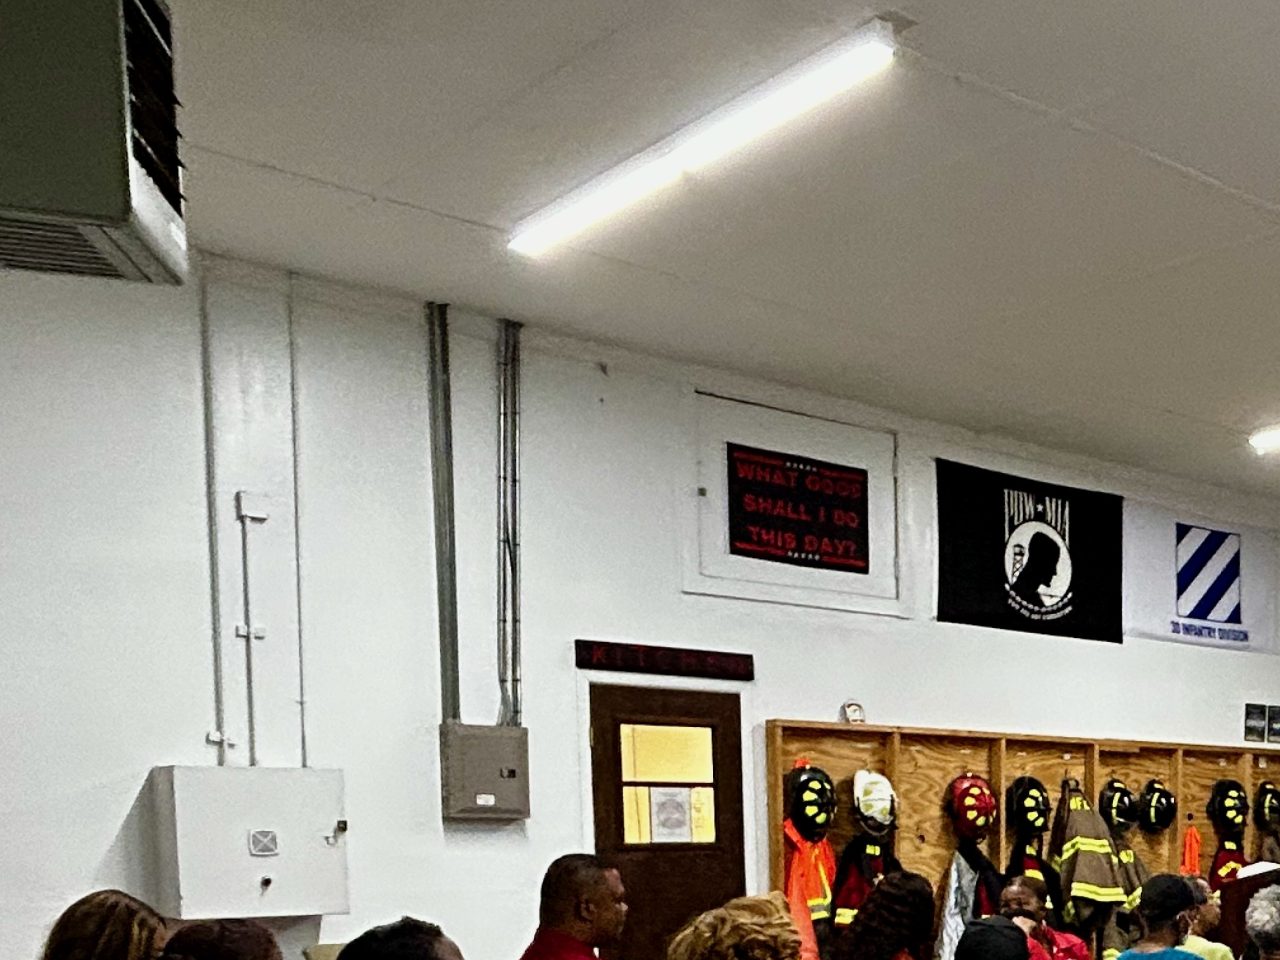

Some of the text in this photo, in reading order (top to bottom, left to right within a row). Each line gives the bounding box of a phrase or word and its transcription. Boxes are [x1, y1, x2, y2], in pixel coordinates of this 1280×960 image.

[736, 462, 862, 498] WHAT GOOD
[743, 494, 811, 521] SHALL
[833, 510, 860, 528] DO
[748, 525, 796, 549] THIS
